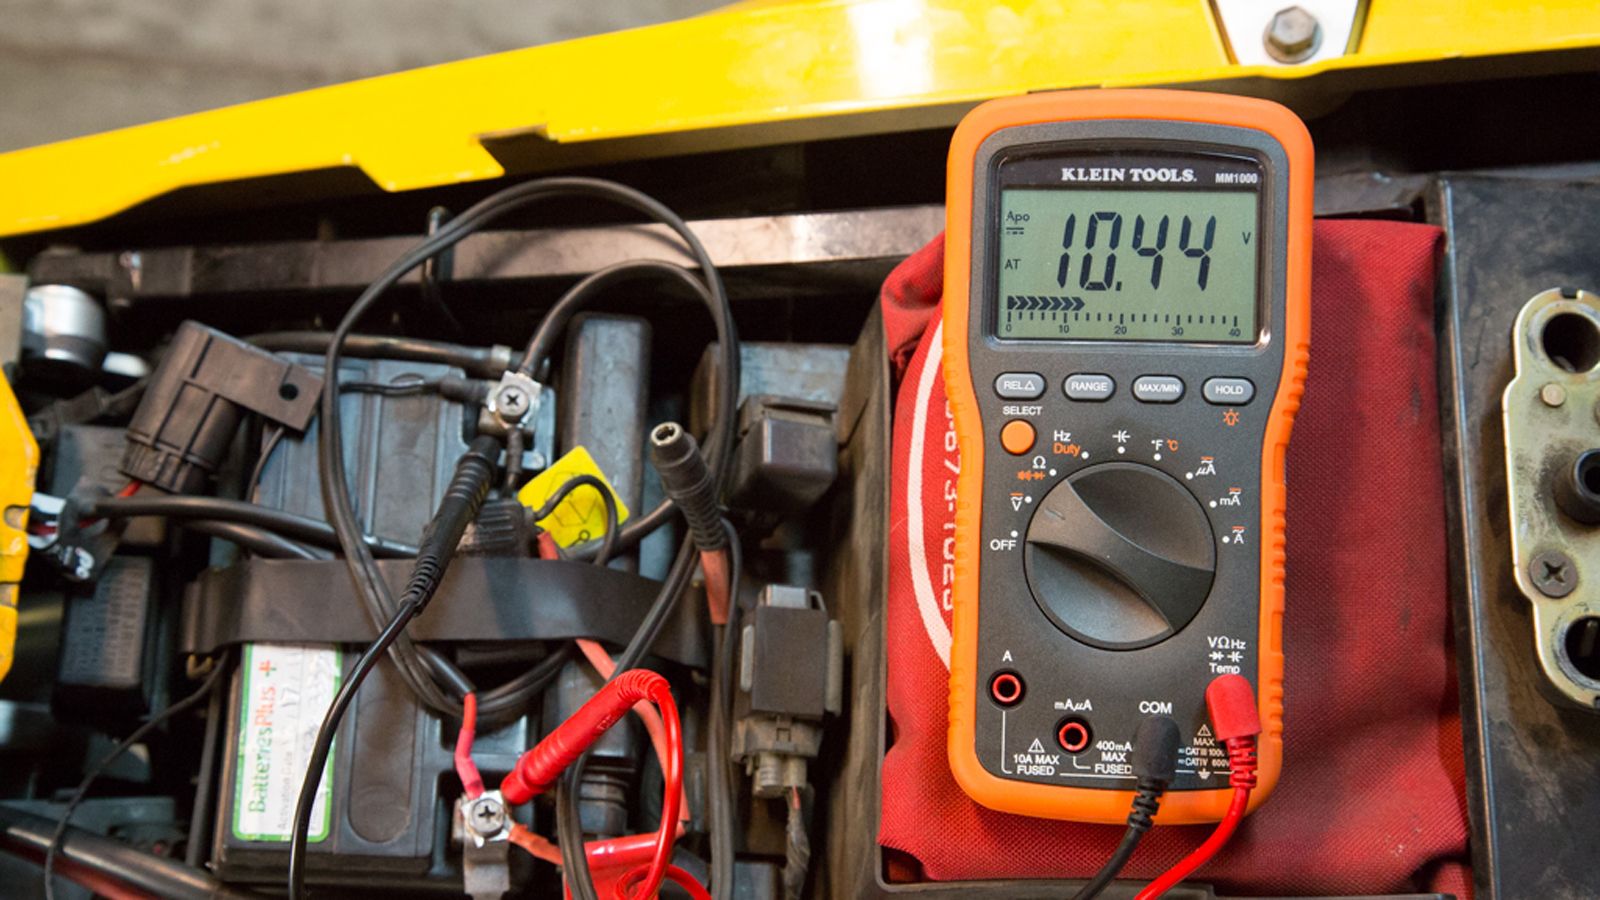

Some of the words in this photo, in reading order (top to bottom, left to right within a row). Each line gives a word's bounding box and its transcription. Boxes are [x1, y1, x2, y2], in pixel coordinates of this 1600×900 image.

[1061, 168, 1124, 182] KLEIN
[1215, 173, 1258, 184] MM1000
[1006, 210, 1030, 224] Apo
[1242, 232, 1251, 244] V
[1057, 211, 1216, 291] 10.44
[1005, 259, 1021, 270] AT
[1005, 325, 1012, 333] 0
[1059, 325, 1070, 334] 10
[1114, 325, 1128, 335] 20
[1171, 326, 1184, 336] 30
[1229, 327, 1241, 337] 40
[1071, 381, 1108, 391] RANGE
[1138, 382, 1180, 394] MAX/MIN
[1215, 385, 1244, 395] HOLD
[1003, 405, 1043, 416] SELECT
[1053, 429, 1072, 442] Hz
[1053, 442, 1081, 457] Duty
[1219, 494, 1241, 506] mA
[990, 539, 1017, 551] OFF
[1002, 650, 1013, 662] A
[1209, 663, 1241, 675] Temp
[1139, 701, 1172, 714] COM
[1095, 740, 1133, 752] 400mA
[1193, 737, 1215, 746] MAX
[1013, 754, 1034, 764] 10A
[1035, 755, 1060, 765] MAX
[1101, 752, 1127, 763] MAX
[1016, 765, 1056, 776] FUSED
[1094, 763, 1133, 775] FUSED
